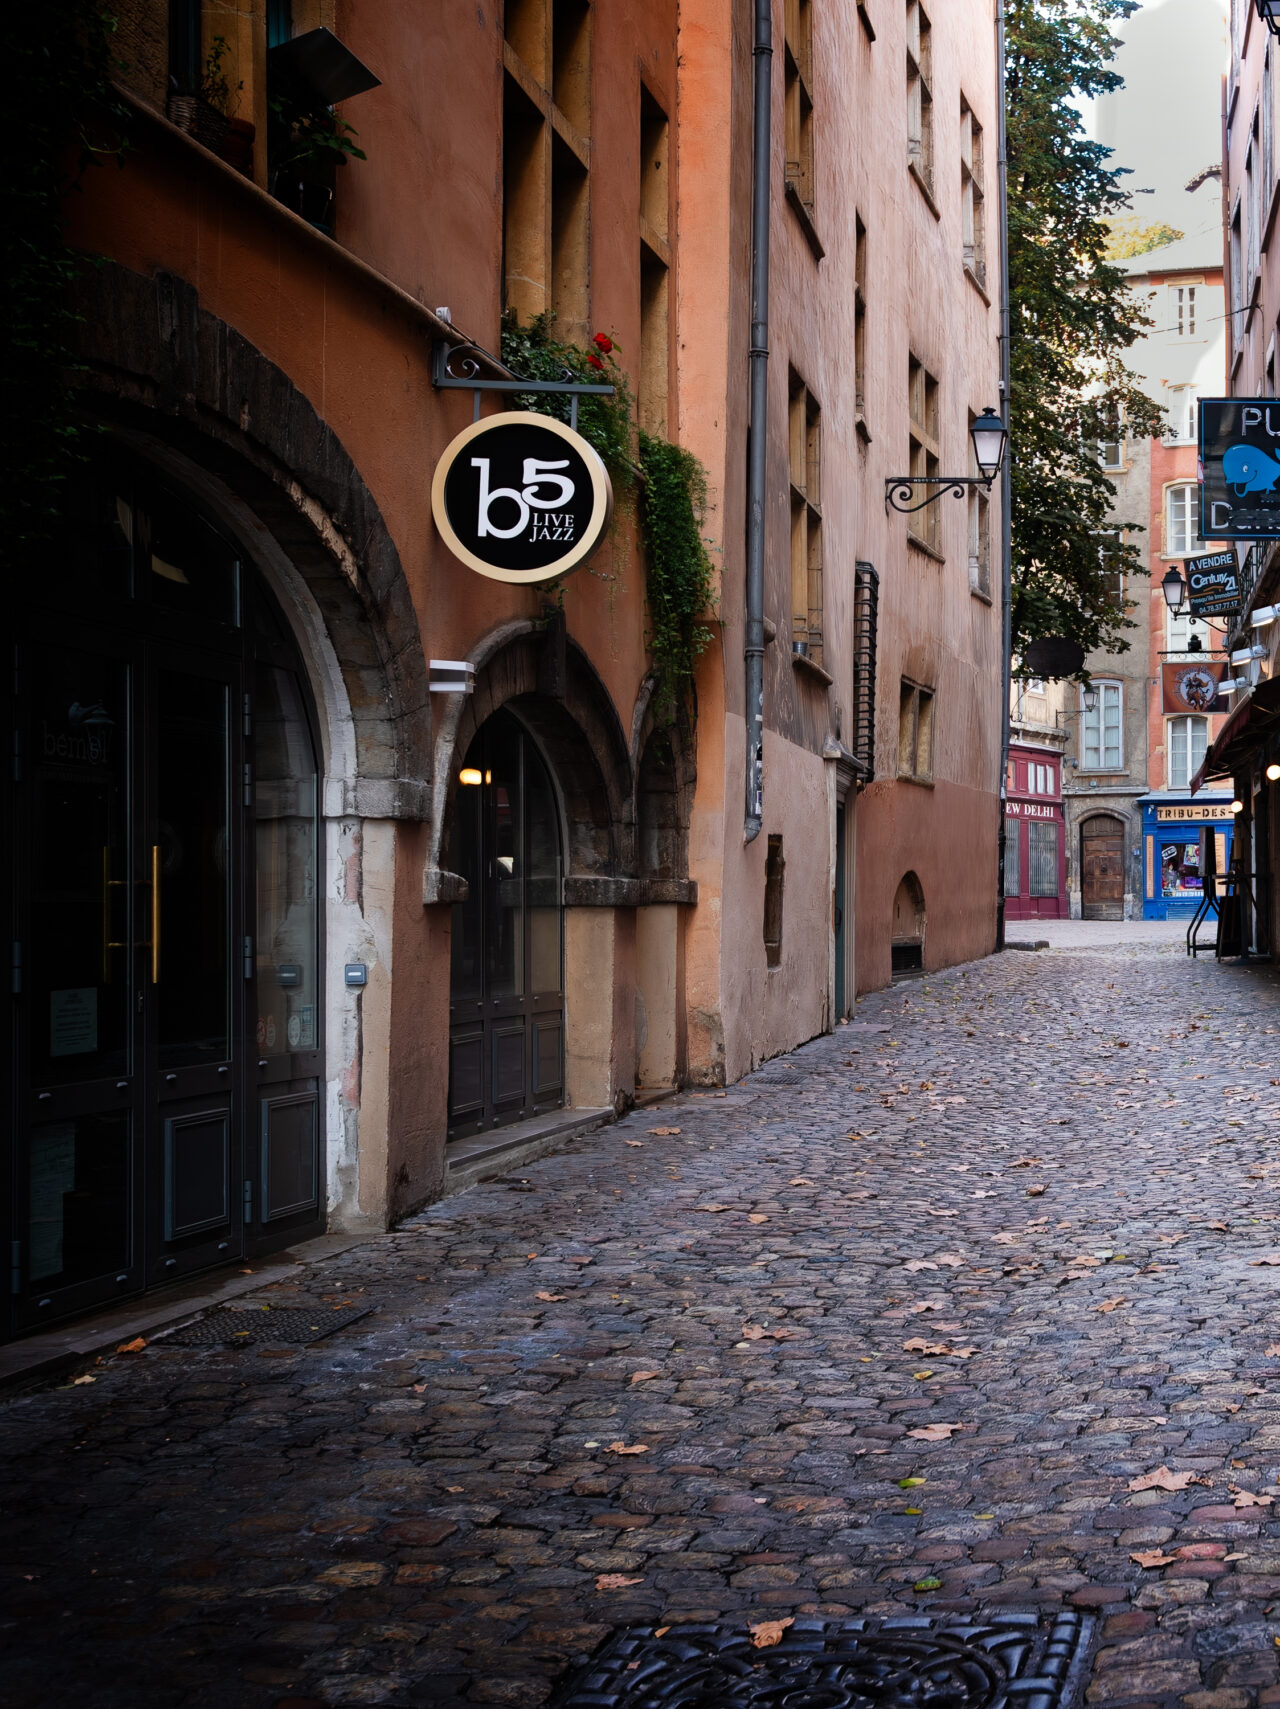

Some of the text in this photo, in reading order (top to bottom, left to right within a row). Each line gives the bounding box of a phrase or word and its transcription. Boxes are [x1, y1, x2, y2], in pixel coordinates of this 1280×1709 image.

[471, 457, 576, 540] b5
[533, 512, 575, 528] LIVE
[529, 526, 575, 543] JAZZ
[1189, 553, 1233, 571] A VENDRE
[1191, 573, 1236, 591] Century 21
[1023, 803, 1055, 818] DELHI
